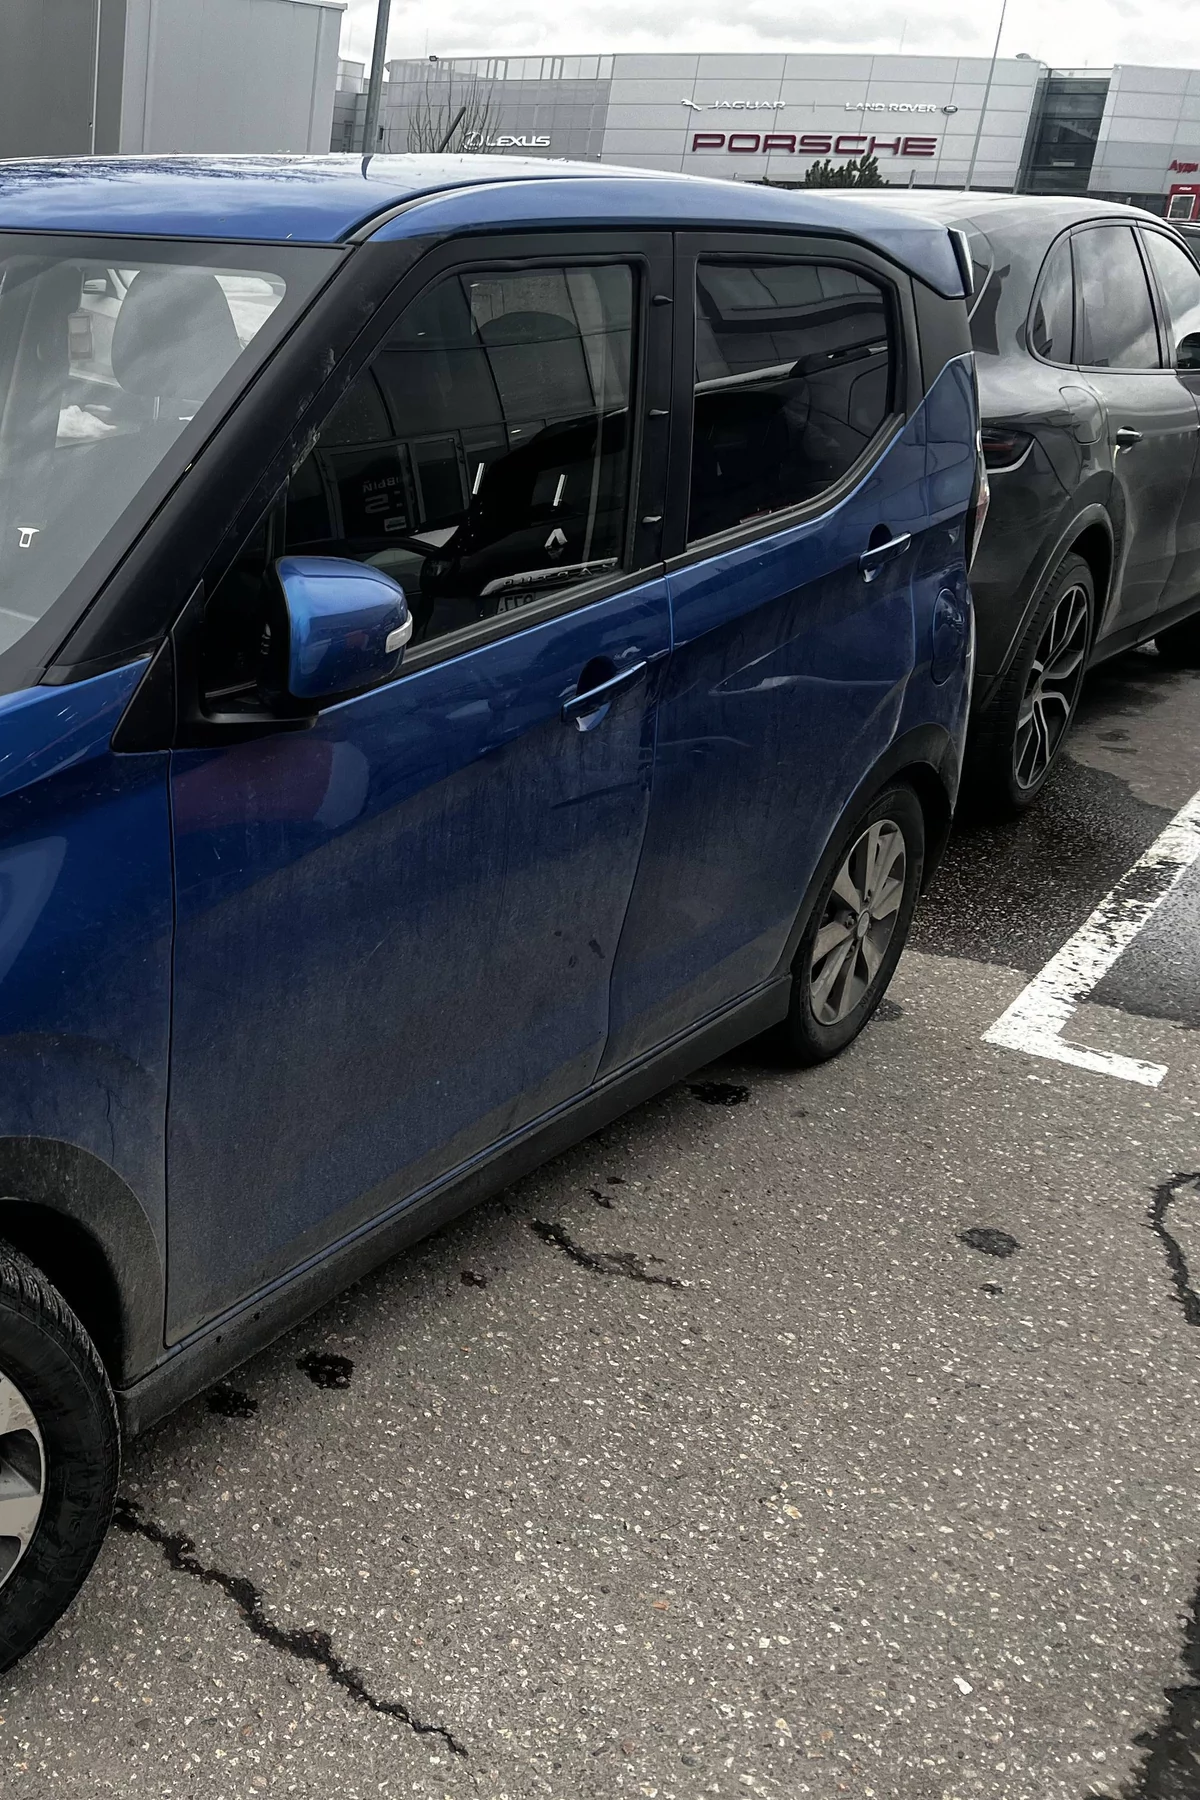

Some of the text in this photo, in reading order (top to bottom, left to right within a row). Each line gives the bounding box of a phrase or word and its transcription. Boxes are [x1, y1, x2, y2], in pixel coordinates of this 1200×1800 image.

[706, 100, 786, 110] JAGUAR
[845, 102, 937, 113] LAND ROVER
[486, 135, 551, 147] LEXUS
[692, 133, 938, 156] PORSCHE
